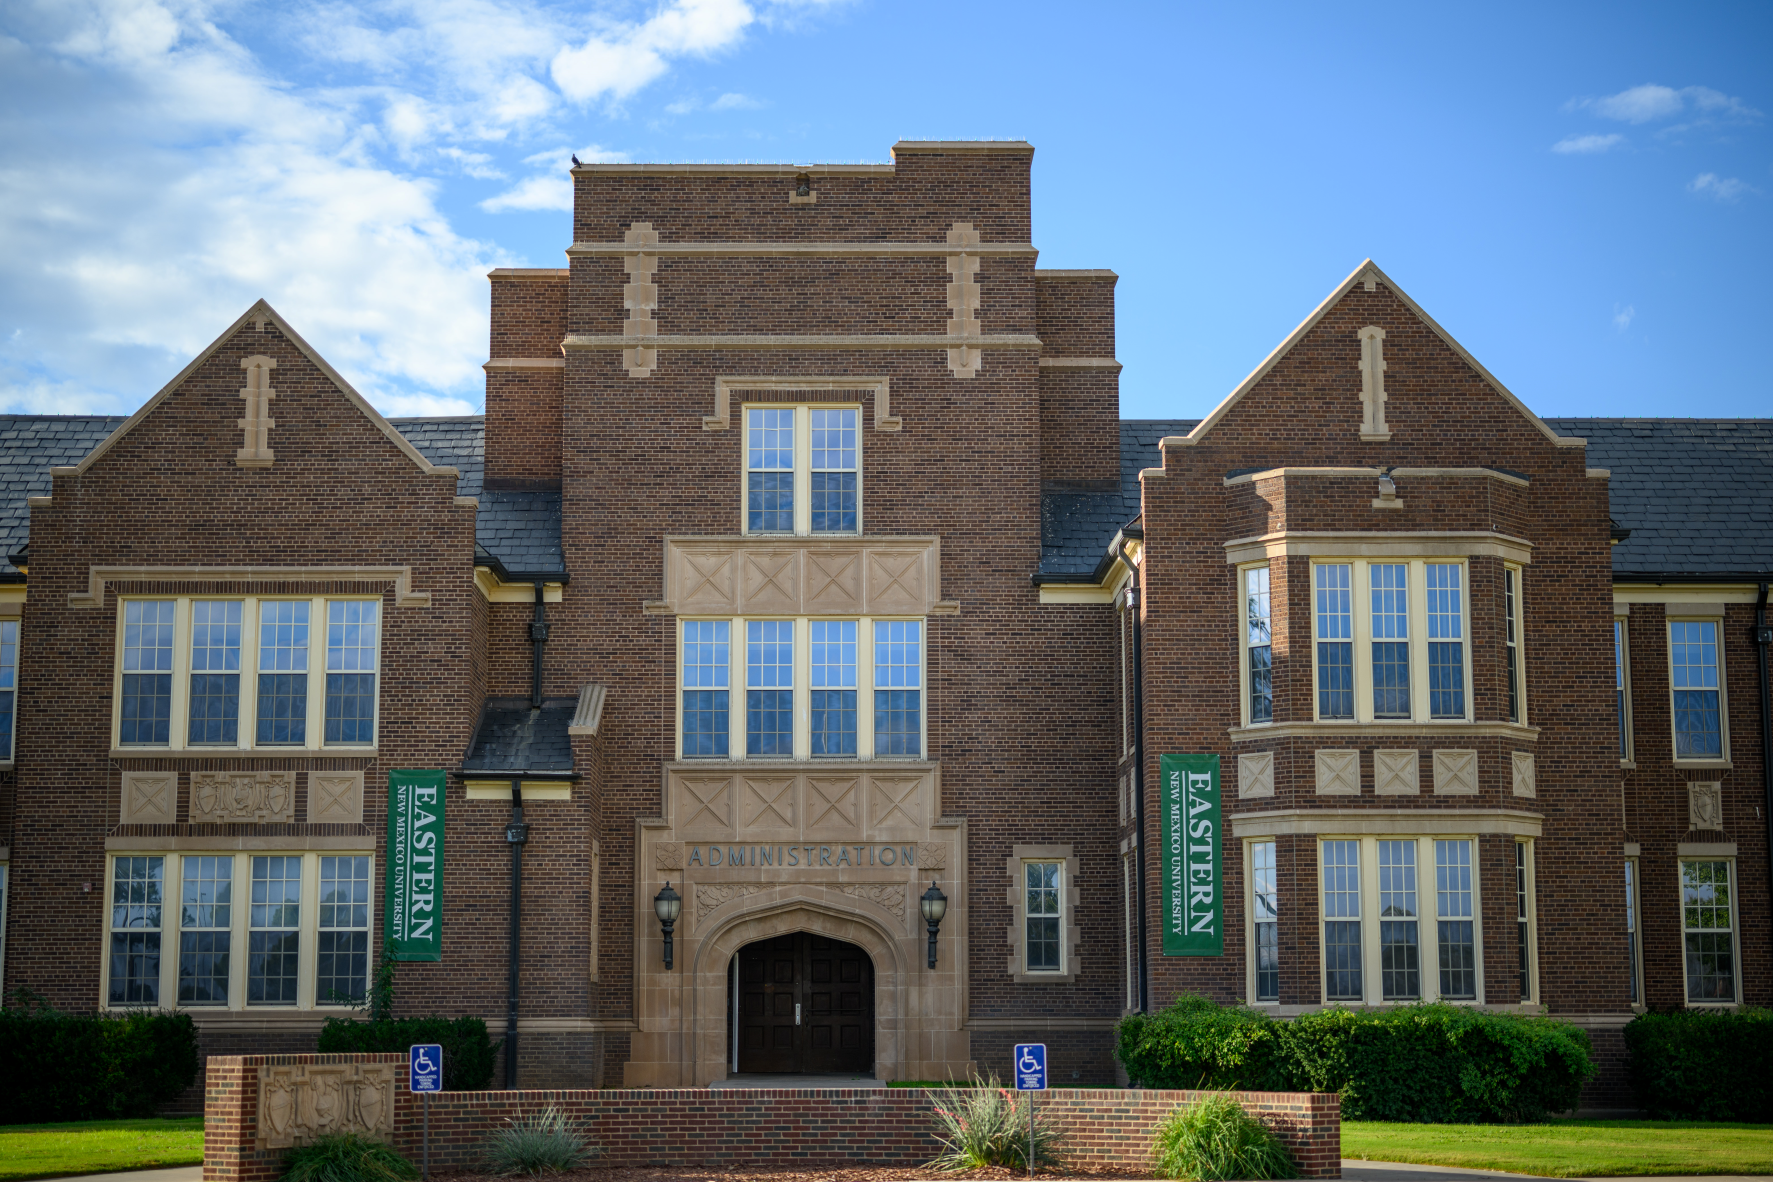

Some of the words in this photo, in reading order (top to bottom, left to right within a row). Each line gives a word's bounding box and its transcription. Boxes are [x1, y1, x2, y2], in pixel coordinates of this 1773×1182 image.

[397, 785, 407, 815] NEW
[1170, 771, 1180, 801] NEW
[395, 816, 406, 864] MEXICO
[1170, 803, 1181, 854] MEXICO
[1188, 770, 1214, 936] EASTERN
[410, 784, 437, 942] EASTERN
[688, 845, 915, 867] ADMINISTRATION
[392, 866, 405, 941] UNIVERSITY
[1171, 856, 1182, 936] UNIVERSITY
